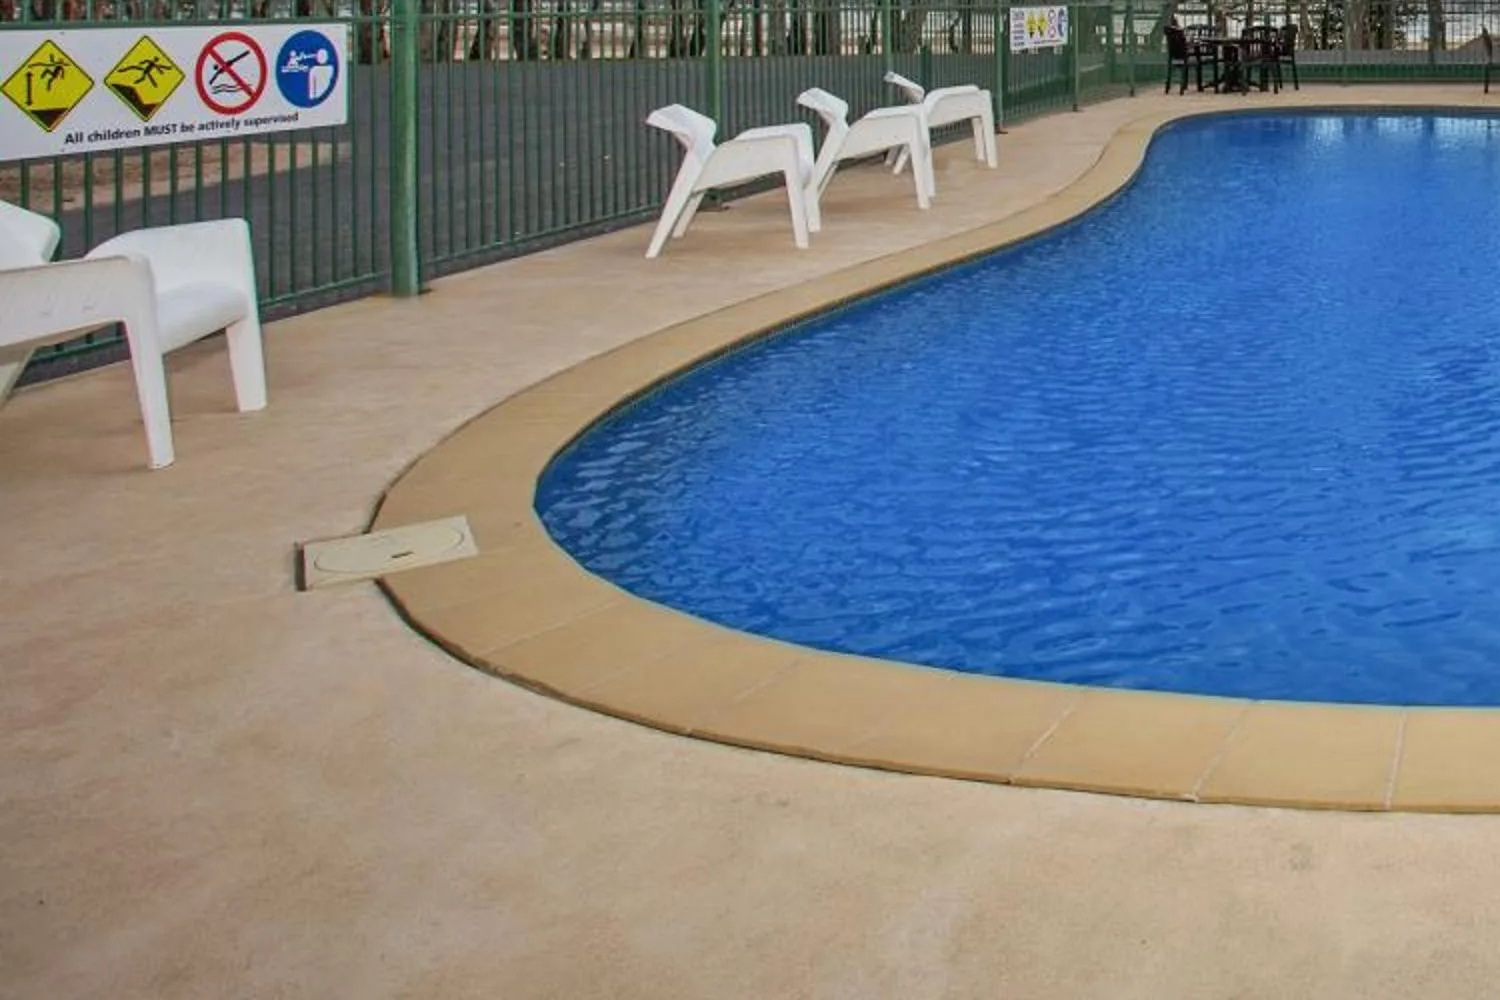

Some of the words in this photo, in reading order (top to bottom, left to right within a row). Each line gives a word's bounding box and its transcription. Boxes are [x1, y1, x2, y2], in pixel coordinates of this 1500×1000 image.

[64, 131, 84, 145] All
[87, 128, 141, 142] children
[143, 123, 178, 136] MUST
[180, 122, 195, 133] be
[198, 117, 241, 131] actively
[243, 111, 299, 128] supervised
